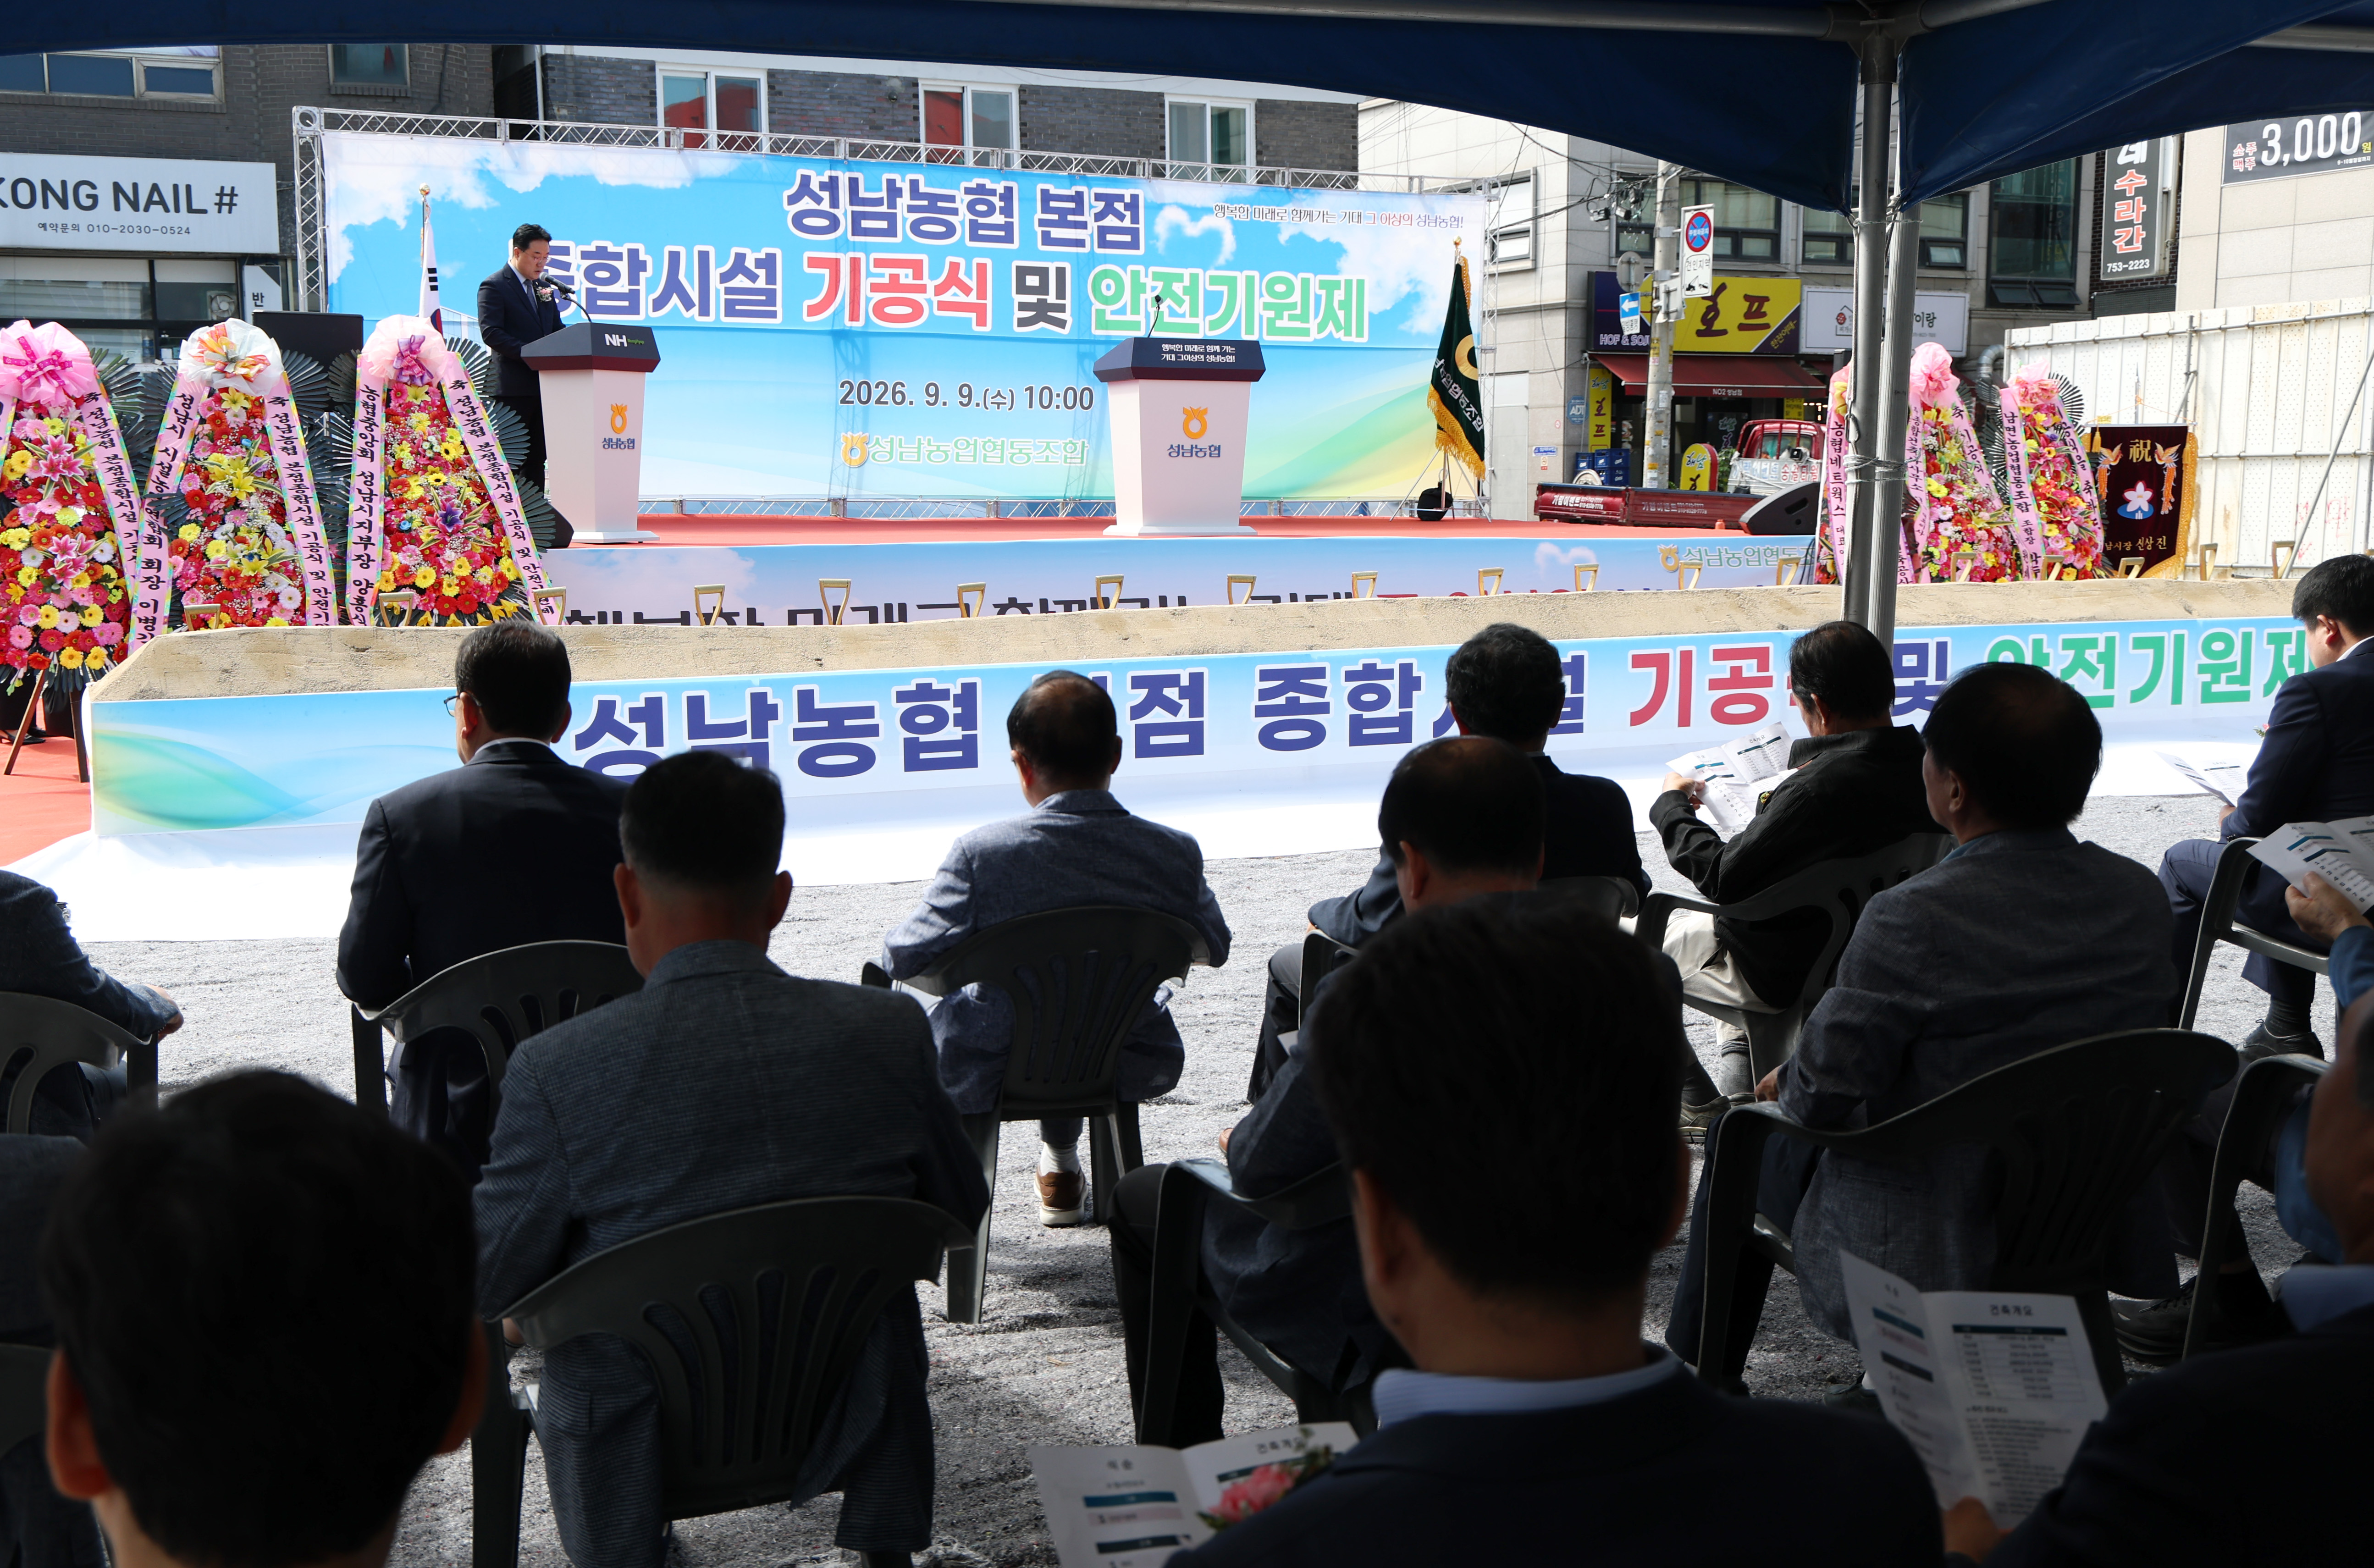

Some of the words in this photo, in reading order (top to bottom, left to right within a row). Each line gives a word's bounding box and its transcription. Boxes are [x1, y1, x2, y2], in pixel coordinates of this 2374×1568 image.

[2232, 142, 2257, 157] 소주
[2261, 112, 2361, 167] 3,000
[2362, 141, 2372, 153] 원
[2232, 157, 2256, 172] 맥주
[112, 181, 208, 215] NAIL
[786, 173, 1015, 246] 성남농협
[1037, 187, 1142, 252] 본점
[2113, 169, 2147, 254] 수라간
[38, 223, 80, 232] 예약문의
[87, 224, 190, 235] 010-2030-0524
[1214, 204, 1250, 220] 행복한
[1254, 207, 1287, 221] 미래로
[1339, 211, 1362, 224] 기대
[1365, 213, 1377, 225] 그
[1380, 213, 1413, 226] 이상의
[1415, 214, 1463, 228] 성남농협!
[1686, 258, 1711, 272] 견인지역
[2107, 259, 2150, 273] 753-2223
[806, 256, 988, 328] 기공식
[1015, 264, 1069, 330] 및
[1093, 268, 1364, 339] 안전기원제
[1695, 282, 1772, 338] 호프
[1914, 312, 1937, 328] 이랑
[604, 334, 627, 347] NH
[1599, 334, 1620, 345] HOF
[1621, 335, 1629, 346] &
[84, 392, 102, 404] 축
[448, 379, 469, 391] 축
[839, 380, 914, 406] 2026.
[924, 382, 948, 407] 9.
[1024, 386, 1094, 411] 10:00
[165, 393, 195, 439] 성남시
[268, 396, 289, 407] 축
[454, 394, 486, 438] 성남농협
[1569, 405, 1586, 415] ADT
[85, 407, 116, 450] 성남농협
[271, 412, 299, 457] 성남농협
[357, 384, 381, 463] 농협중앙회
[602, 437, 635, 450] 성남농협
[871, 436, 1089, 465] 성남농업협동조합
[1167, 444, 1221, 458] 성남농협
[2129, 439, 2153, 463] 祝
[475, 442, 514, 503] 본점종합시설
[1686, 451, 1707, 470] 해남
[100, 454, 138, 523] 본점종합시설
[282, 461, 314, 527] 본점종합시설
[351, 471, 379, 569] 성남시지부장
[503, 509, 526, 541] 기공식
[2021, 520, 2036, 545] 조합장
[301, 531, 325, 565] 기공식
[515, 547, 532, 558] 및
[140, 558, 166, 590] 회장
[308, 569, 326, 581] 및
[311, 586, 332, 626] 안전기
[574, 681, 979, 783] 성남농협
[1089, 671, 1204, 759] 점
[1254, 654, 1585, 752] 종합
[1629, 646, 1797, 729] 기공
[1892, 640, 1949, 717] 및
